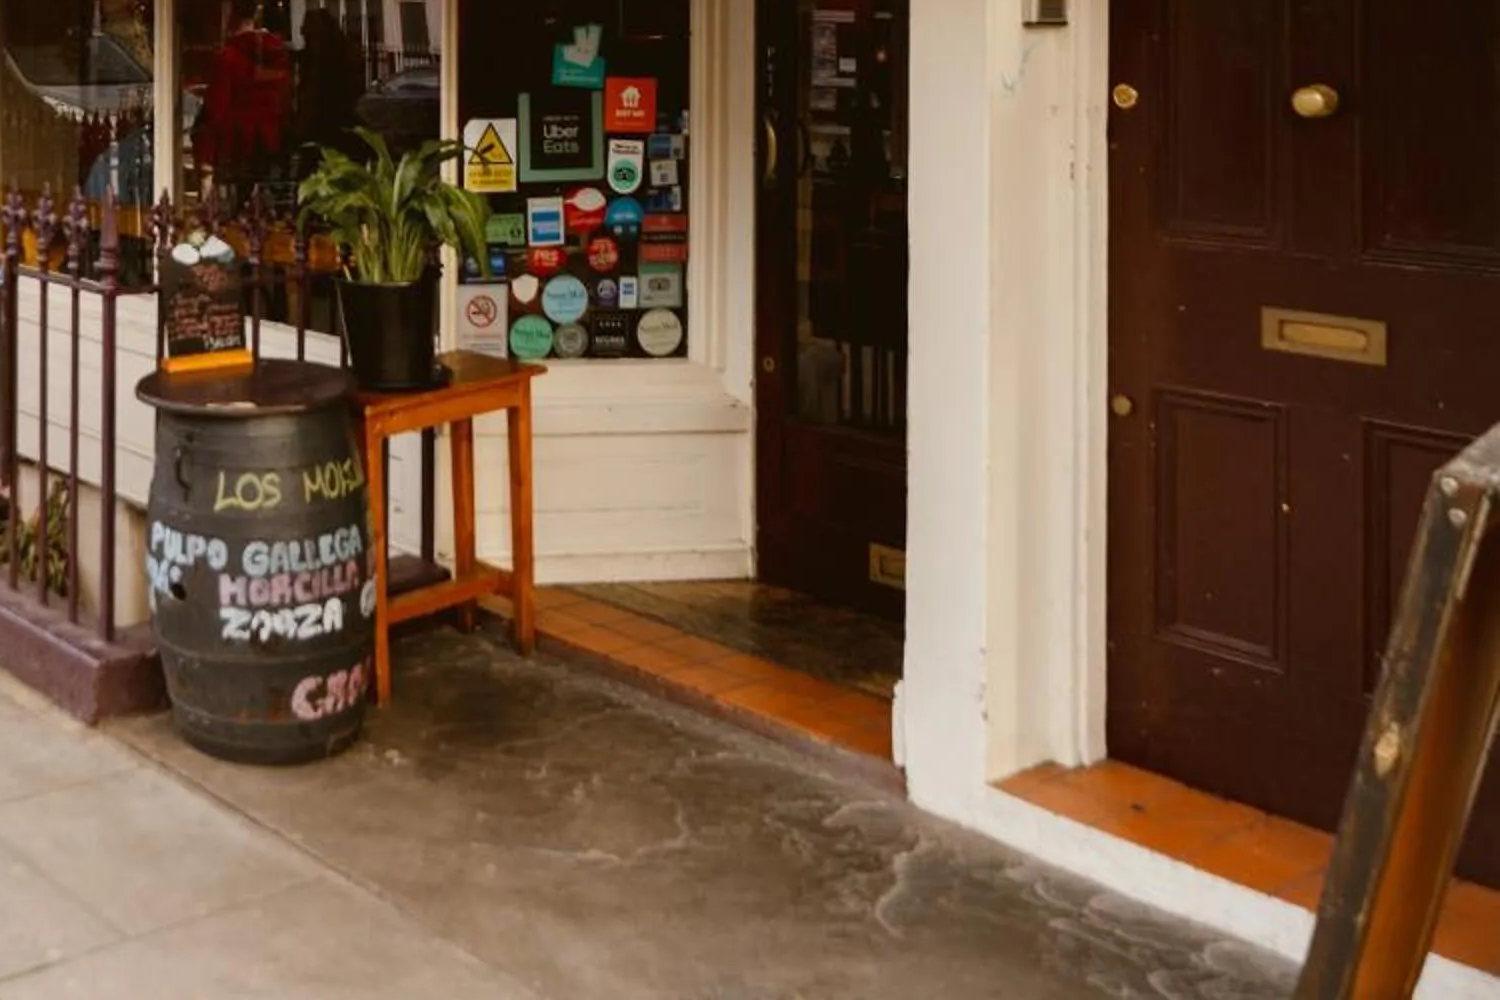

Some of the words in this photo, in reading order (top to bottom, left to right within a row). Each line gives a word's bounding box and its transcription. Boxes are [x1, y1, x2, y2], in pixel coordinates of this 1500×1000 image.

[543, 122, 579, 140] Uber
[543, 140, 579, 154] Eats
[212, 471, 283, 514] LOS
[150, 519, 229, 571] PULPO
[241, 523, 363, 577] GALLEGA
[218, 560, 360, 608] MORCILLA
